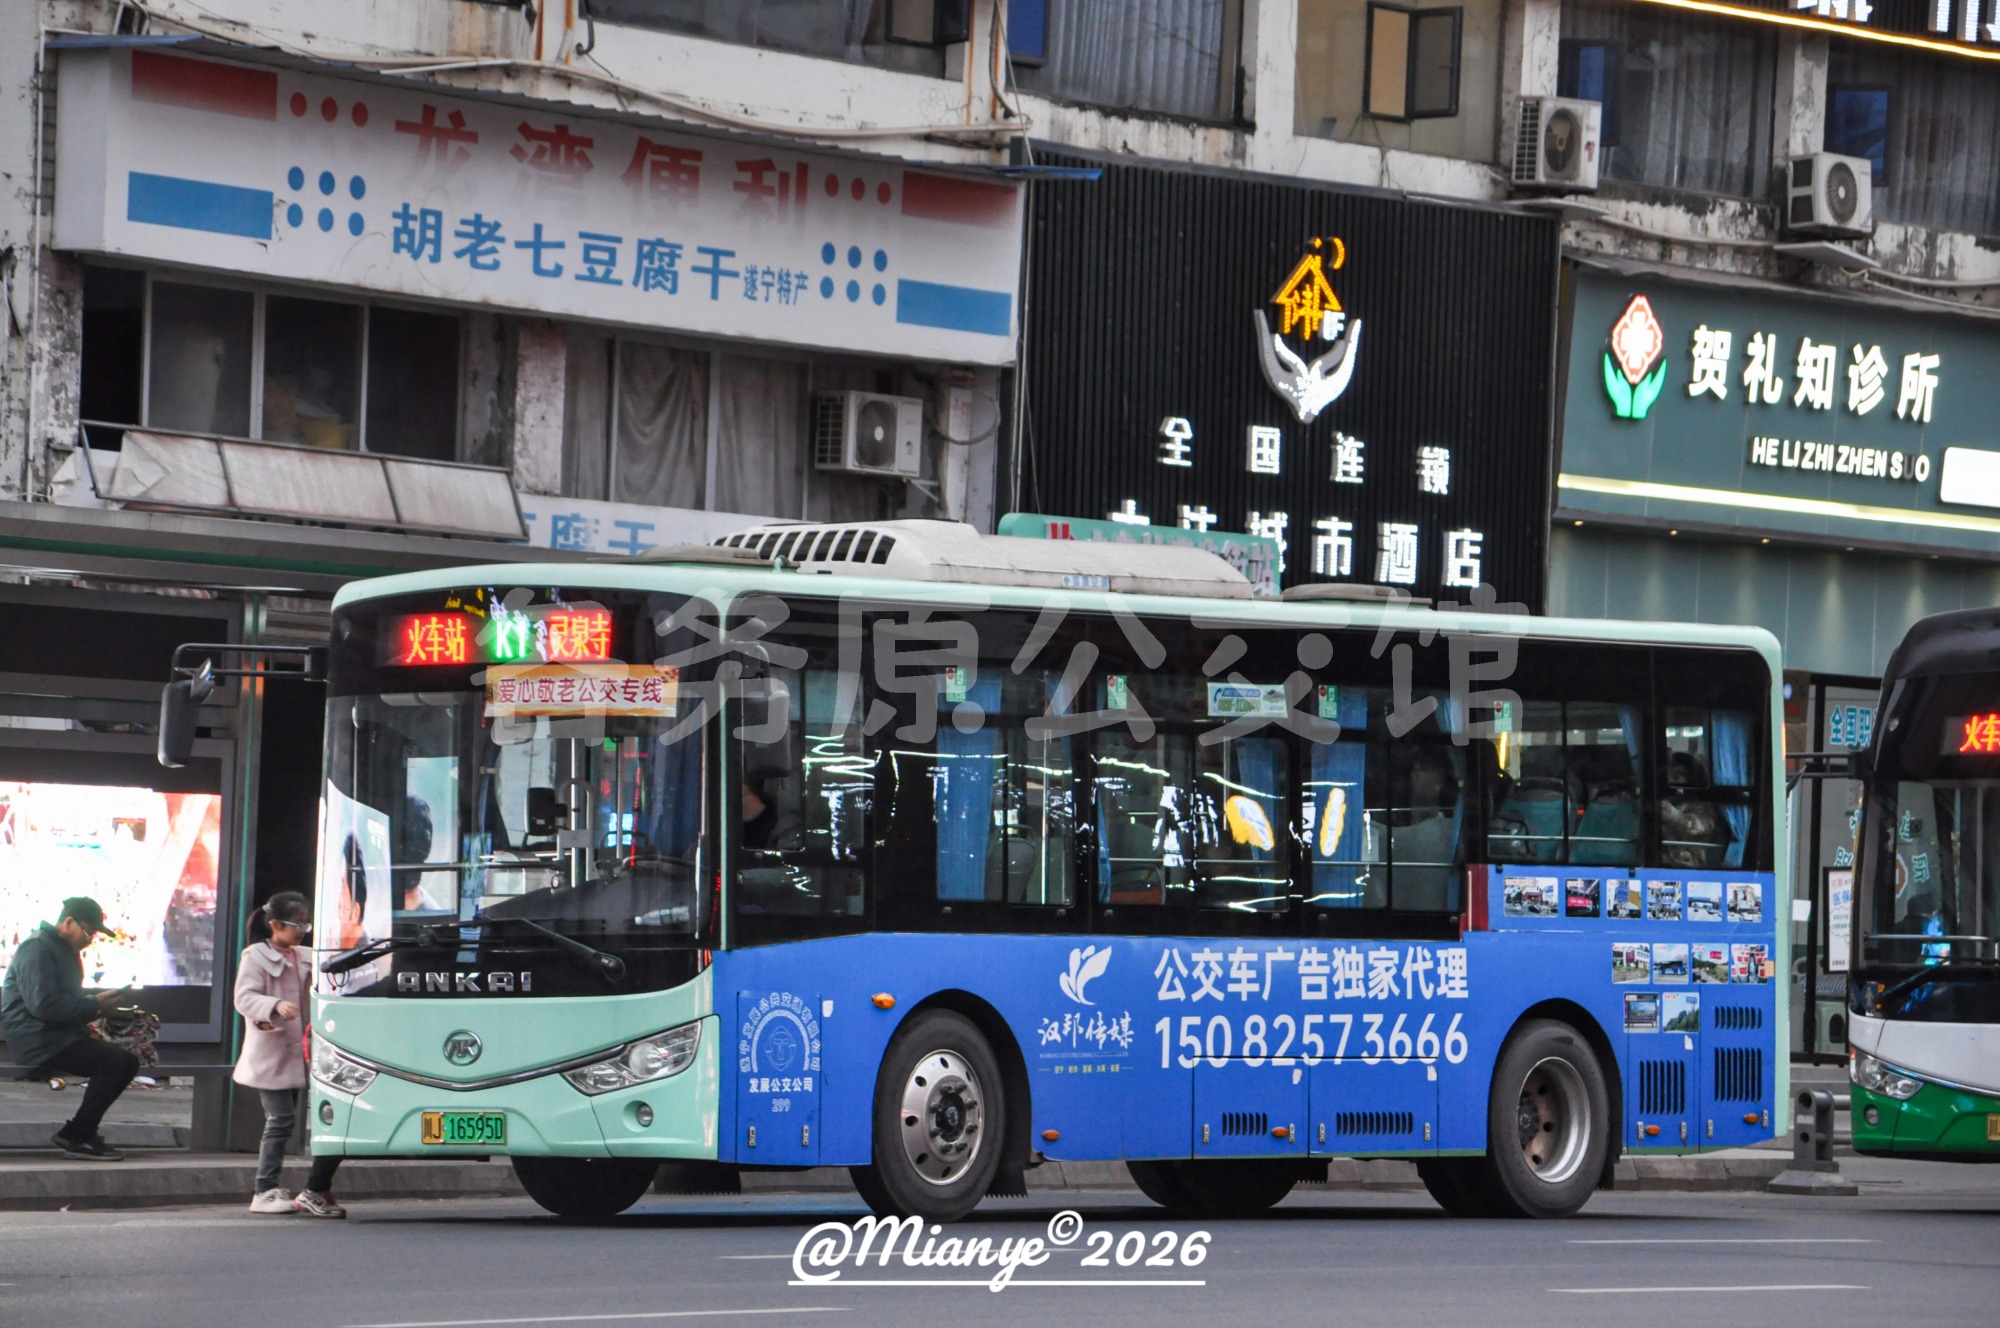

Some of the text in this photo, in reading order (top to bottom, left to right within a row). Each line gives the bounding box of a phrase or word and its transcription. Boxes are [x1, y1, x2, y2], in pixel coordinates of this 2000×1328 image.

[394, 104, 809, 226] 龙湾便利
[391, 201, 809, 305] 胡老七豆腐干 遂宁特产
[1688, 325, 1940, 424] 贺礼知诊所
[1157, 416, 1449, 495] 全国连锁
[1752, 436, 1779, 466] HE
[1781, 440, 1801, 468] LI
[1801, 442, 1835, 472] ZHI
[1836, 445, 1888, 478] ZHEN
[406, 613, 610, 662] 火车站 K1 灵泉寺
[498, 676, 662, 704] 爱心敬老公交专线
[397, 971, 532, 992] ANKAI
[1154, 946, 1469, 1002] 公交车广告独家代理
[1037, 1010, 1134, 1050] 汉邦传媒
[749, 1077, 813, 1093] 发展公交公司
